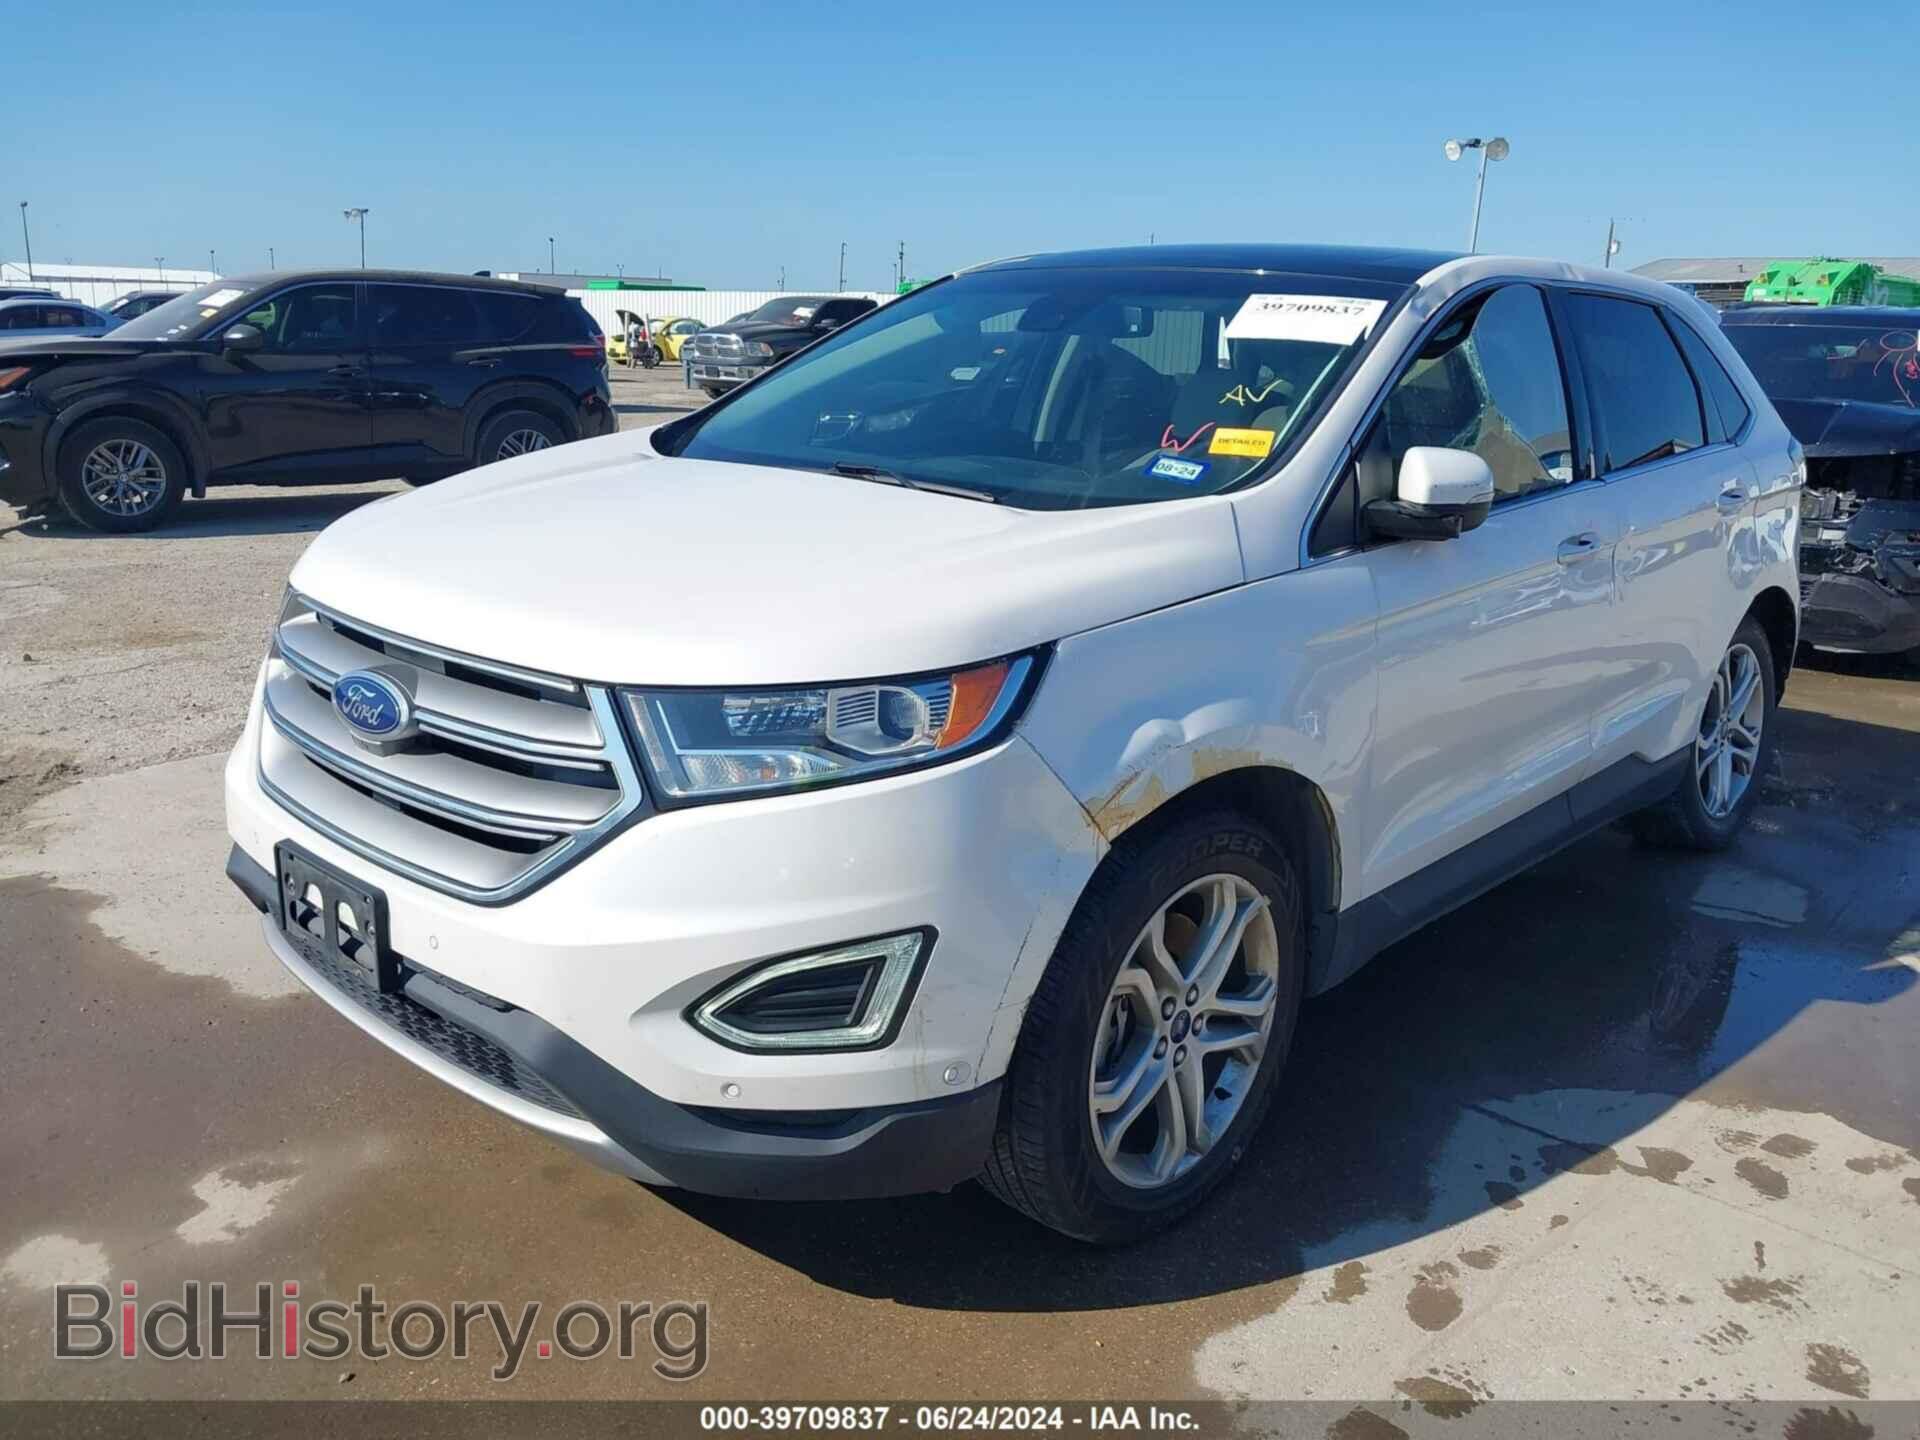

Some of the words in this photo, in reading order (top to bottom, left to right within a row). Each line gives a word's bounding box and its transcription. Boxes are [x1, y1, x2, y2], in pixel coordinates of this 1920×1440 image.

[1256, 302, 1365, 316] 39709837
[1218, 438, 1266, 446] DETAILED
[342, 684, 385, 725] Ford
